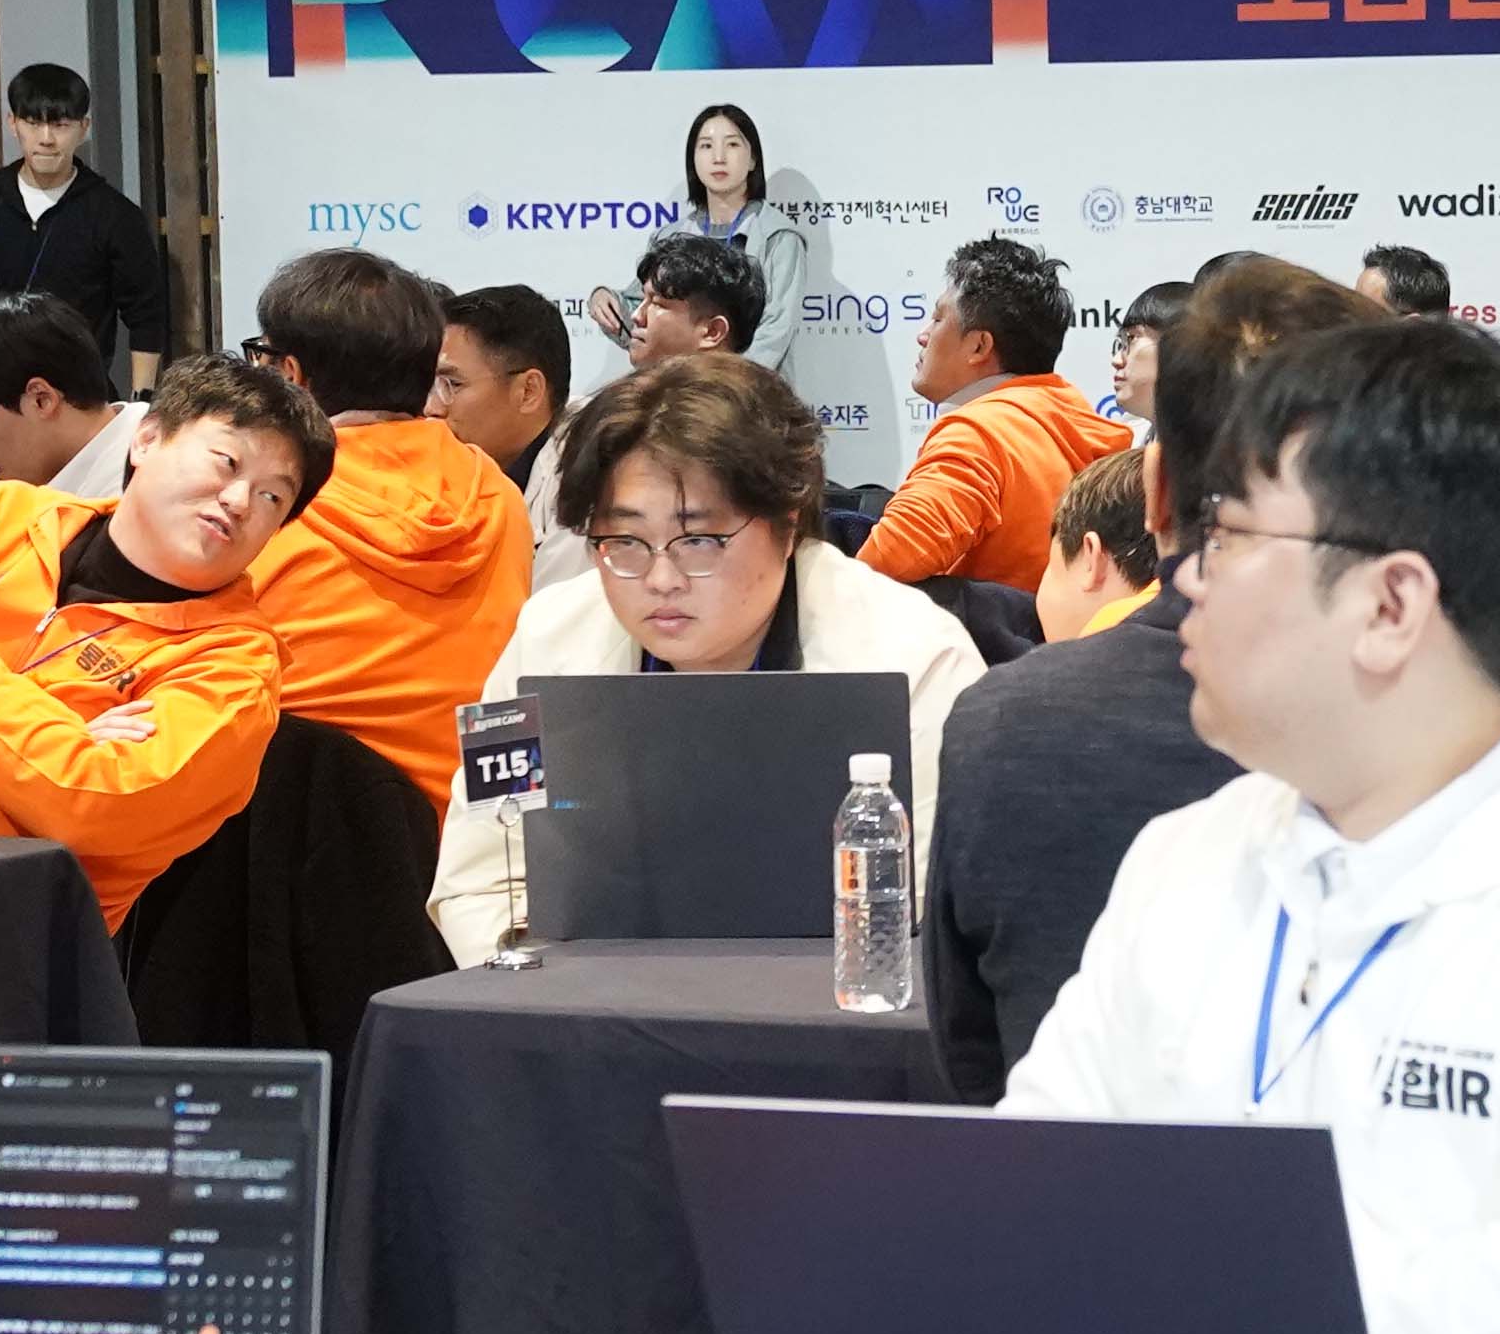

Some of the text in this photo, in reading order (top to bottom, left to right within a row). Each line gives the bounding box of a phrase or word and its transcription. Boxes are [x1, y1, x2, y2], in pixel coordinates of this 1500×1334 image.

[507, 202, 679, 230] KRYPTON
[1135, 194, 1213, 215] 충남대학교
[1252, 184, 1360, 222] series
[308, 201, 422, 246] mysc
[803, 294, 888, 333] sing
[477, 749, 530, 784] T15
